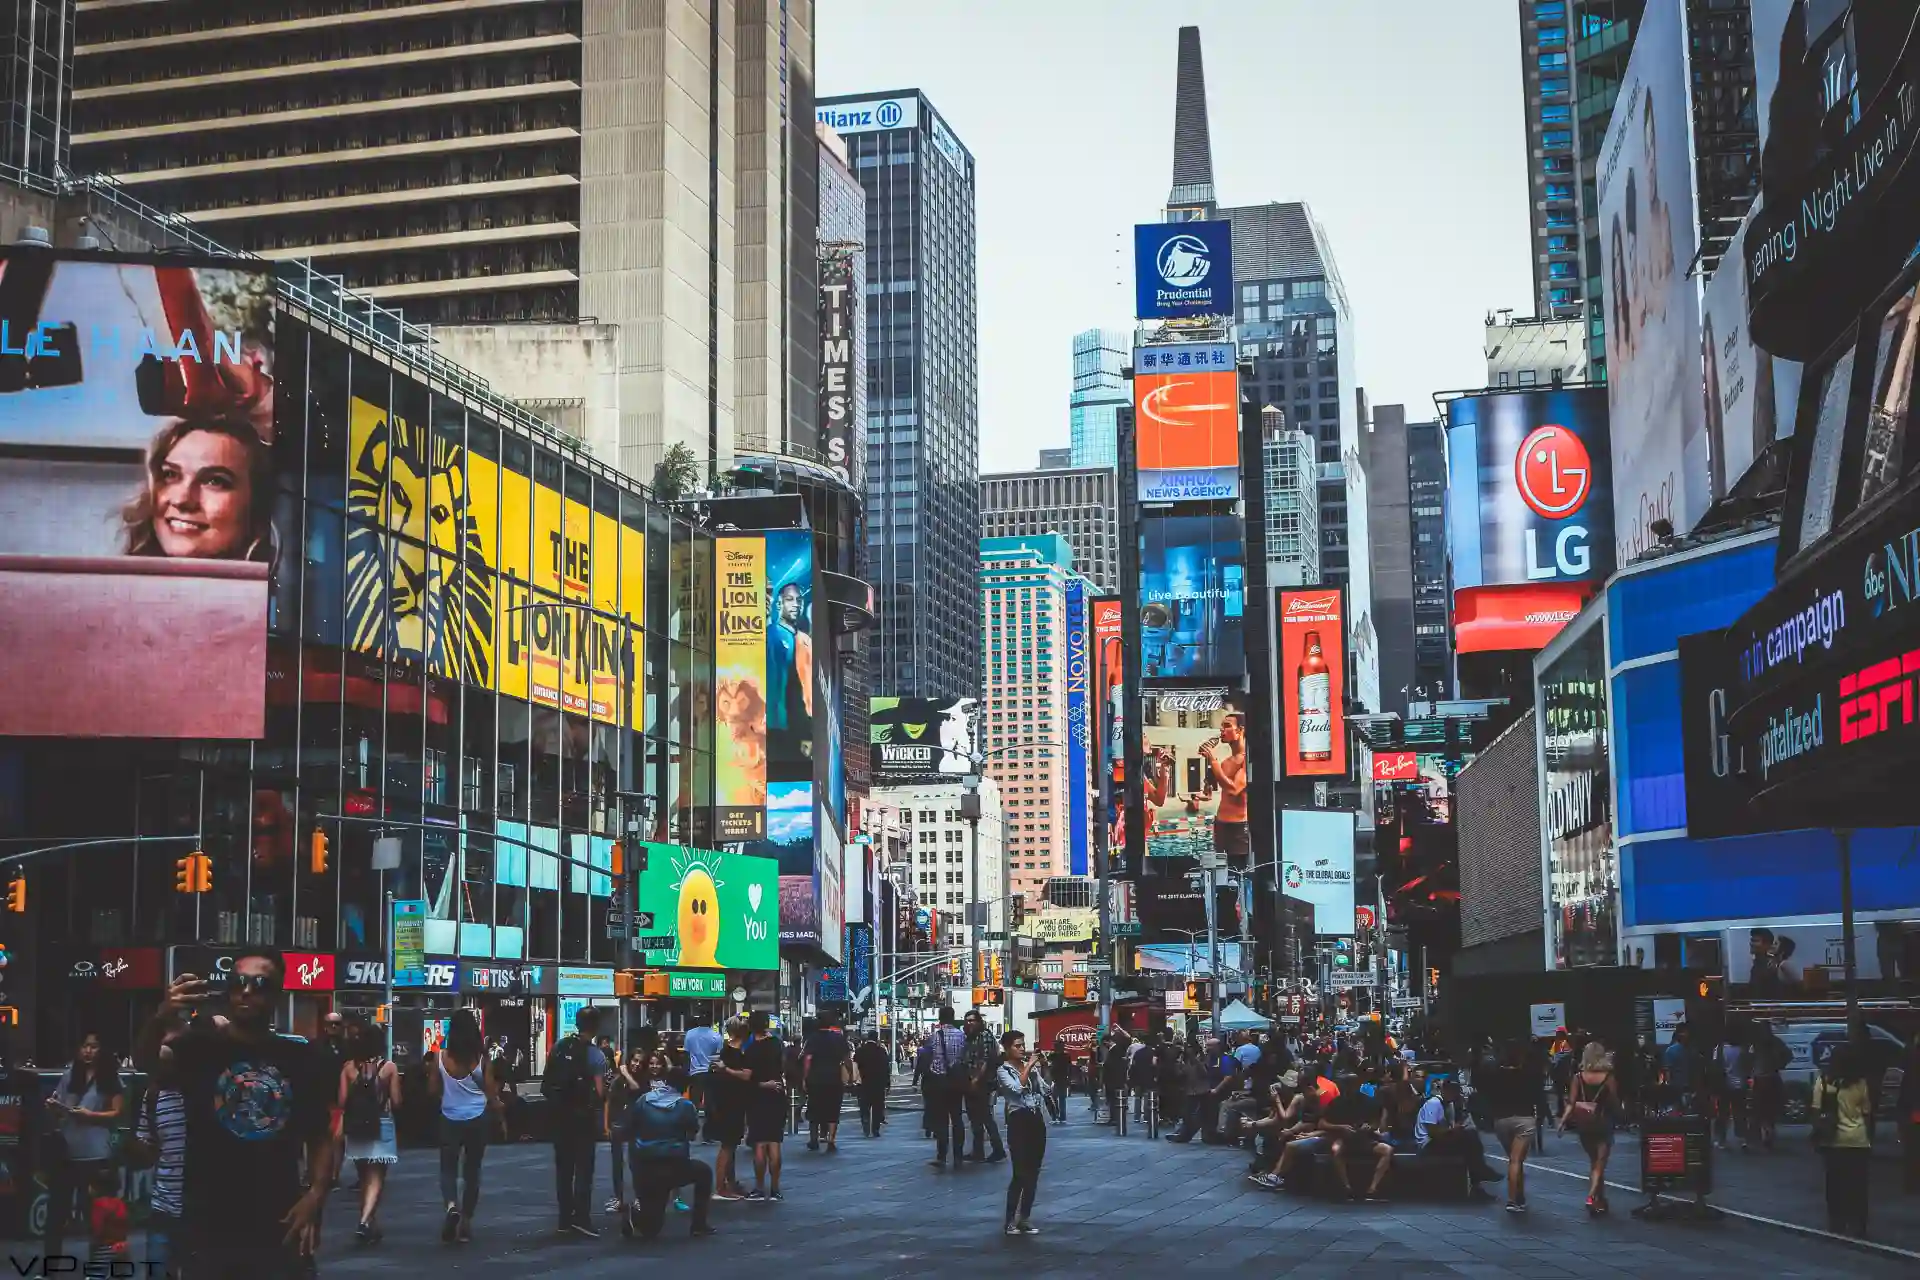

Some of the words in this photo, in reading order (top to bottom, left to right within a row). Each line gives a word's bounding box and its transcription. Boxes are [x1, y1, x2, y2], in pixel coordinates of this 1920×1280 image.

[1801, 167, 1852, 239] Night
[1854, 138, 1884, 192] Live
[1885, 114, 1898, 154] in
[1156, 287, 1213, 300] Prudential
[91, 324, 243, 365] HAAN
[823, 284, 848, 420] TIMES
[1144, 350, 1226, 367] 新华通讯社
[1146, 487, 1181, 498] NEWS
[1183, 485, 1232, 497] AGENCY
[1159, 475, 1218, 488] XINHUA
[550, 530, 590, 584] THE
[723, 550, 754, 561] Disney
[1525, 525, 1590, 580] LG
[726, 572, 752, 585] THE
[1864, 566, 1885, 600] abc
[722, 587, 758, 609] LION
[1149, 591, 1172, 601] Live
[508, 567, 570, 666] LION
[719, 610, 764, 636] KING
[1766, 587, 1846, 668] campaign
[1759, 692, 1824, 781] pitalized
[880, 743, 931, 761] WICKED
[1375, 754, 1414, 776] Ray-Ban
[728, 811, 745, 819] GET
[1546, 787, 1565, 841] OLD
[1565, 767, 1592, 833] NAVY
[1316, 870, 1334, 879] GLOBAL
[1335, 870, 1351, 880] GOALS
[743, 913, 767, 941] YOU
[1121, 924, 1133, 934] 44
[297, 956, 325, 986] Ray-Ban
[672, 977, 687, 991] NEW
[687, 978, 704, 992] YORK
[1059, 1032, 1097, 1042] STRAN
